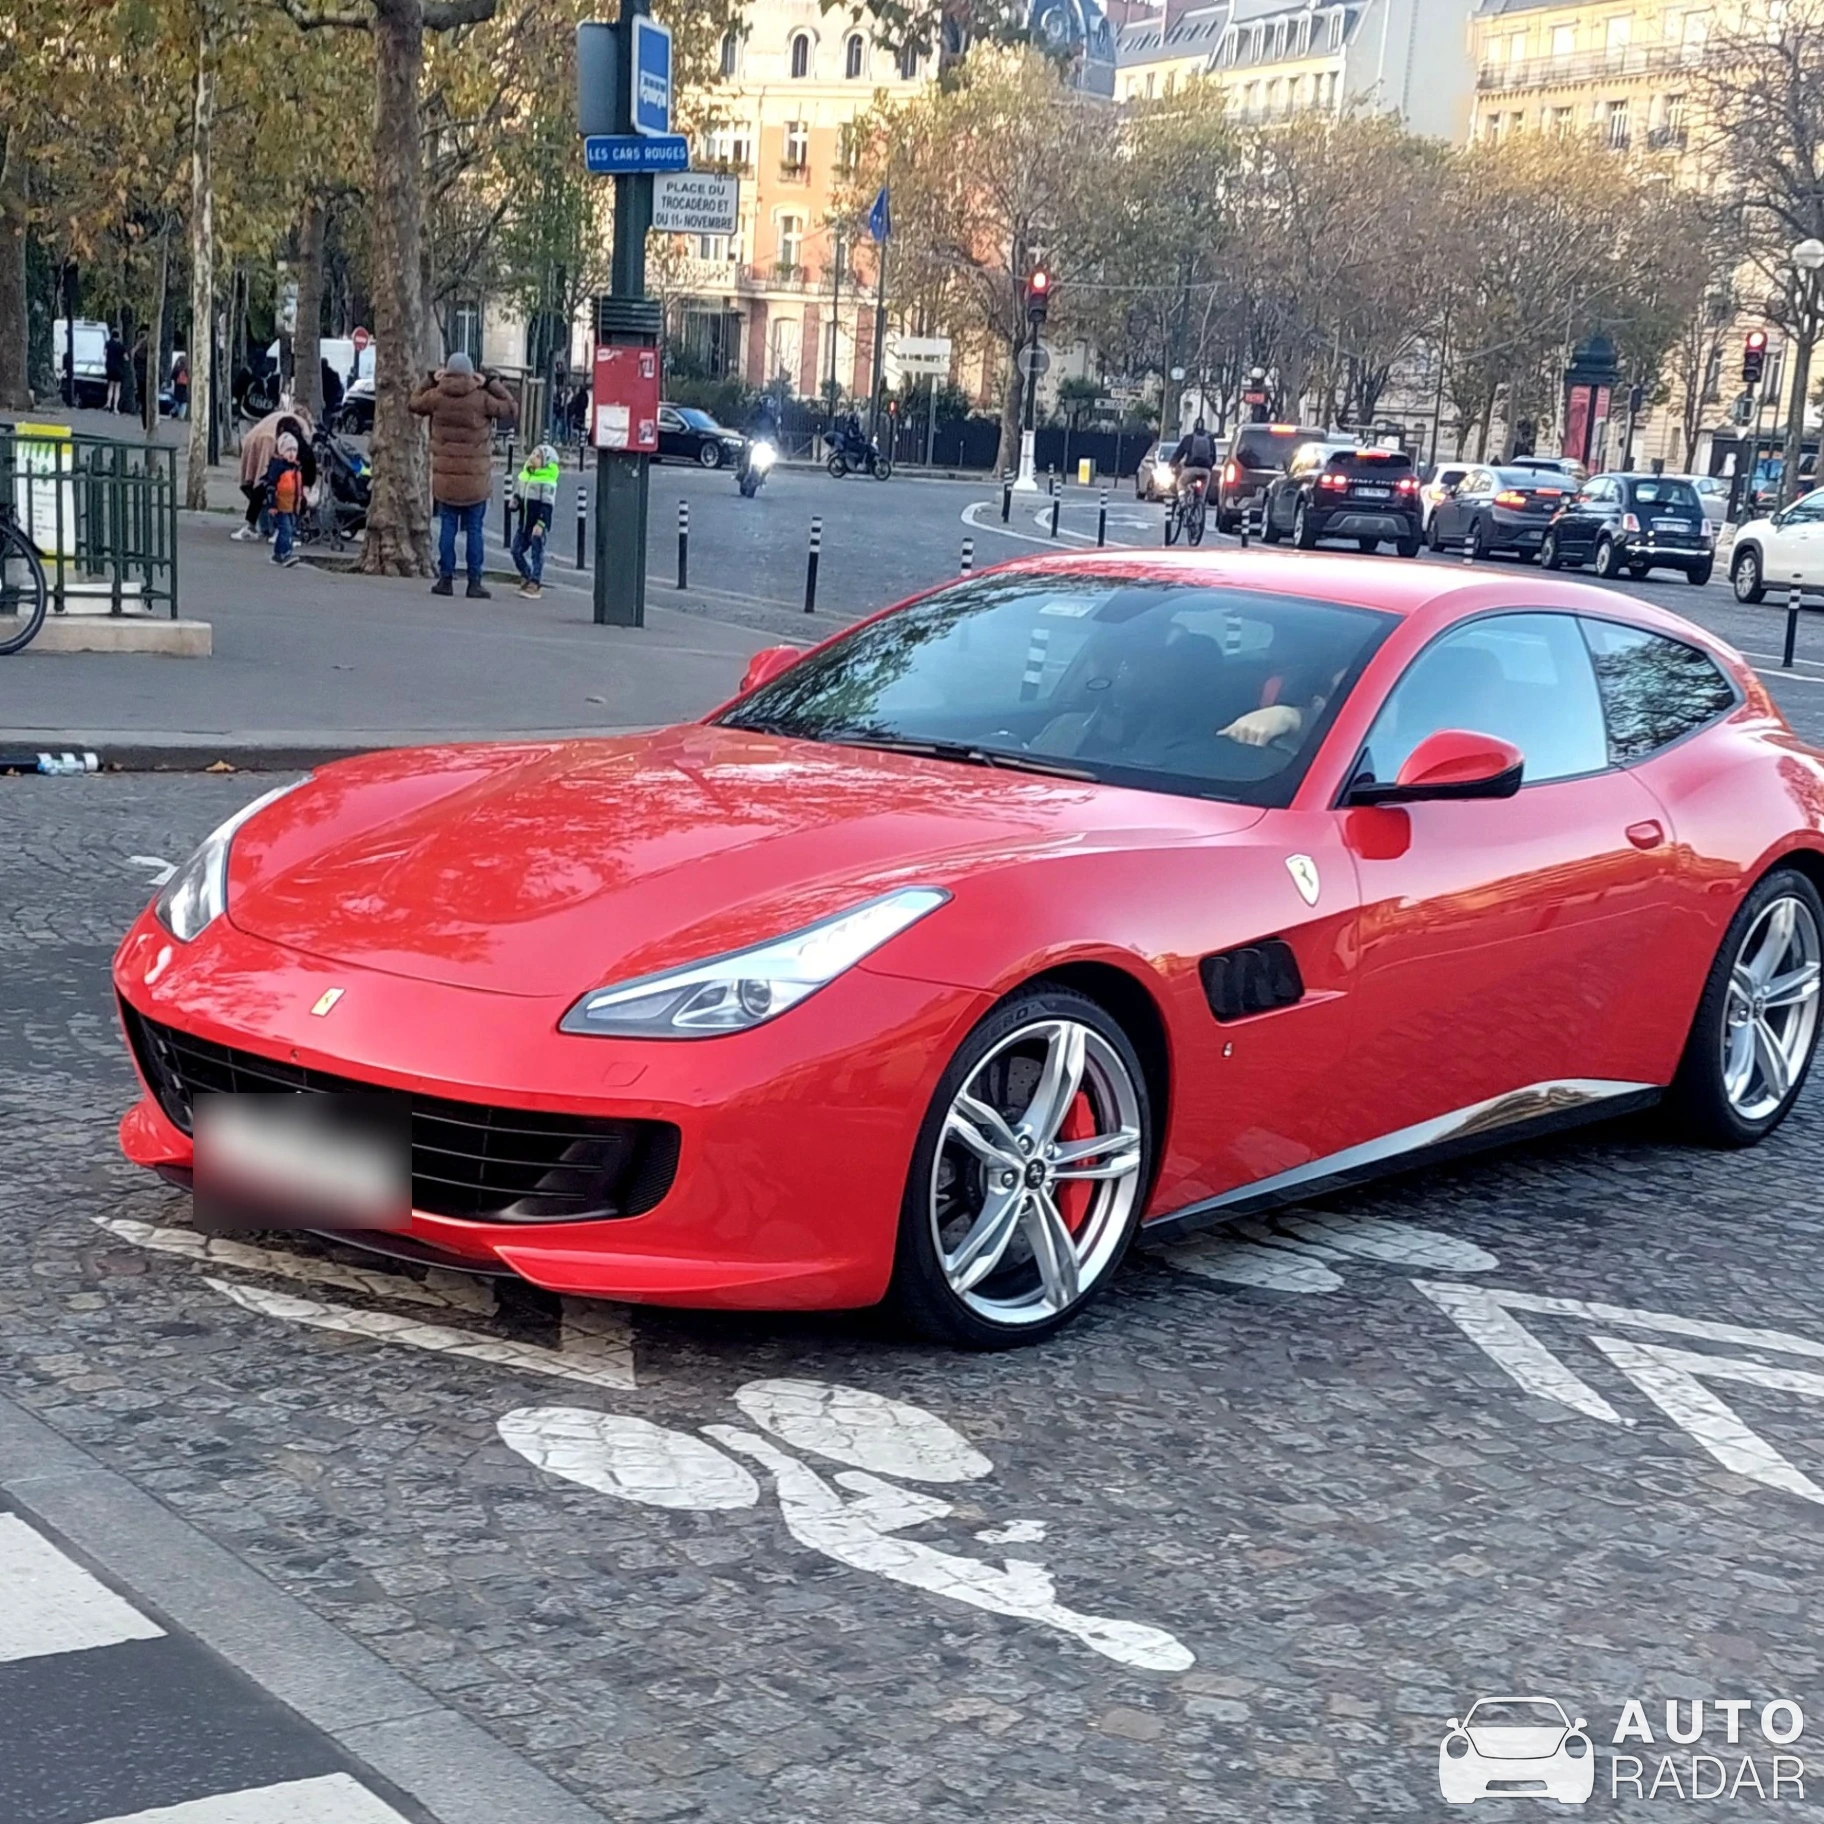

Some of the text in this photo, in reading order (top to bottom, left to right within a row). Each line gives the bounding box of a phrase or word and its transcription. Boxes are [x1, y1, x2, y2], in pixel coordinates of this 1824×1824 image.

[588, 146, 686, 161] LES CARS ROUGES
[666, 182, 726, 196] PLACE DU
[717, 199, 729, 214] ET
[655, 212, 669, 226] DU
